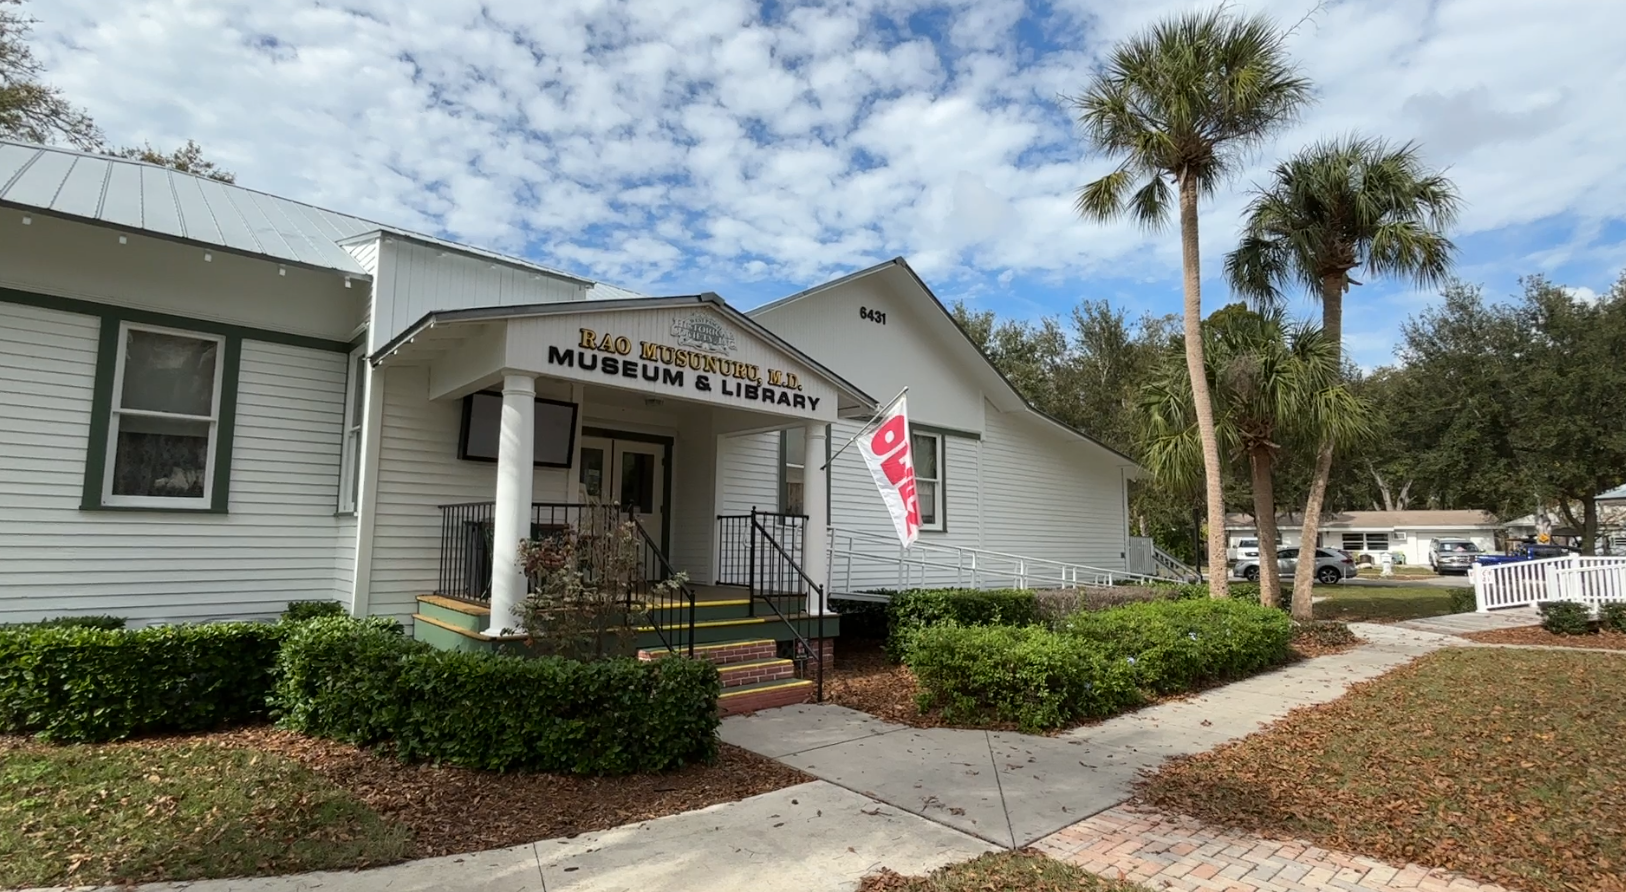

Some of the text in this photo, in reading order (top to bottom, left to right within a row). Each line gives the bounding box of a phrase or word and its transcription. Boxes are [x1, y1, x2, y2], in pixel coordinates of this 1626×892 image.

[860, 306, 886, 325] 6431
[548, 345, 820, 411] MUSEUM & LIBRARY
[578, 328, 803, 391] RAO MUSUNURU, M.D.
